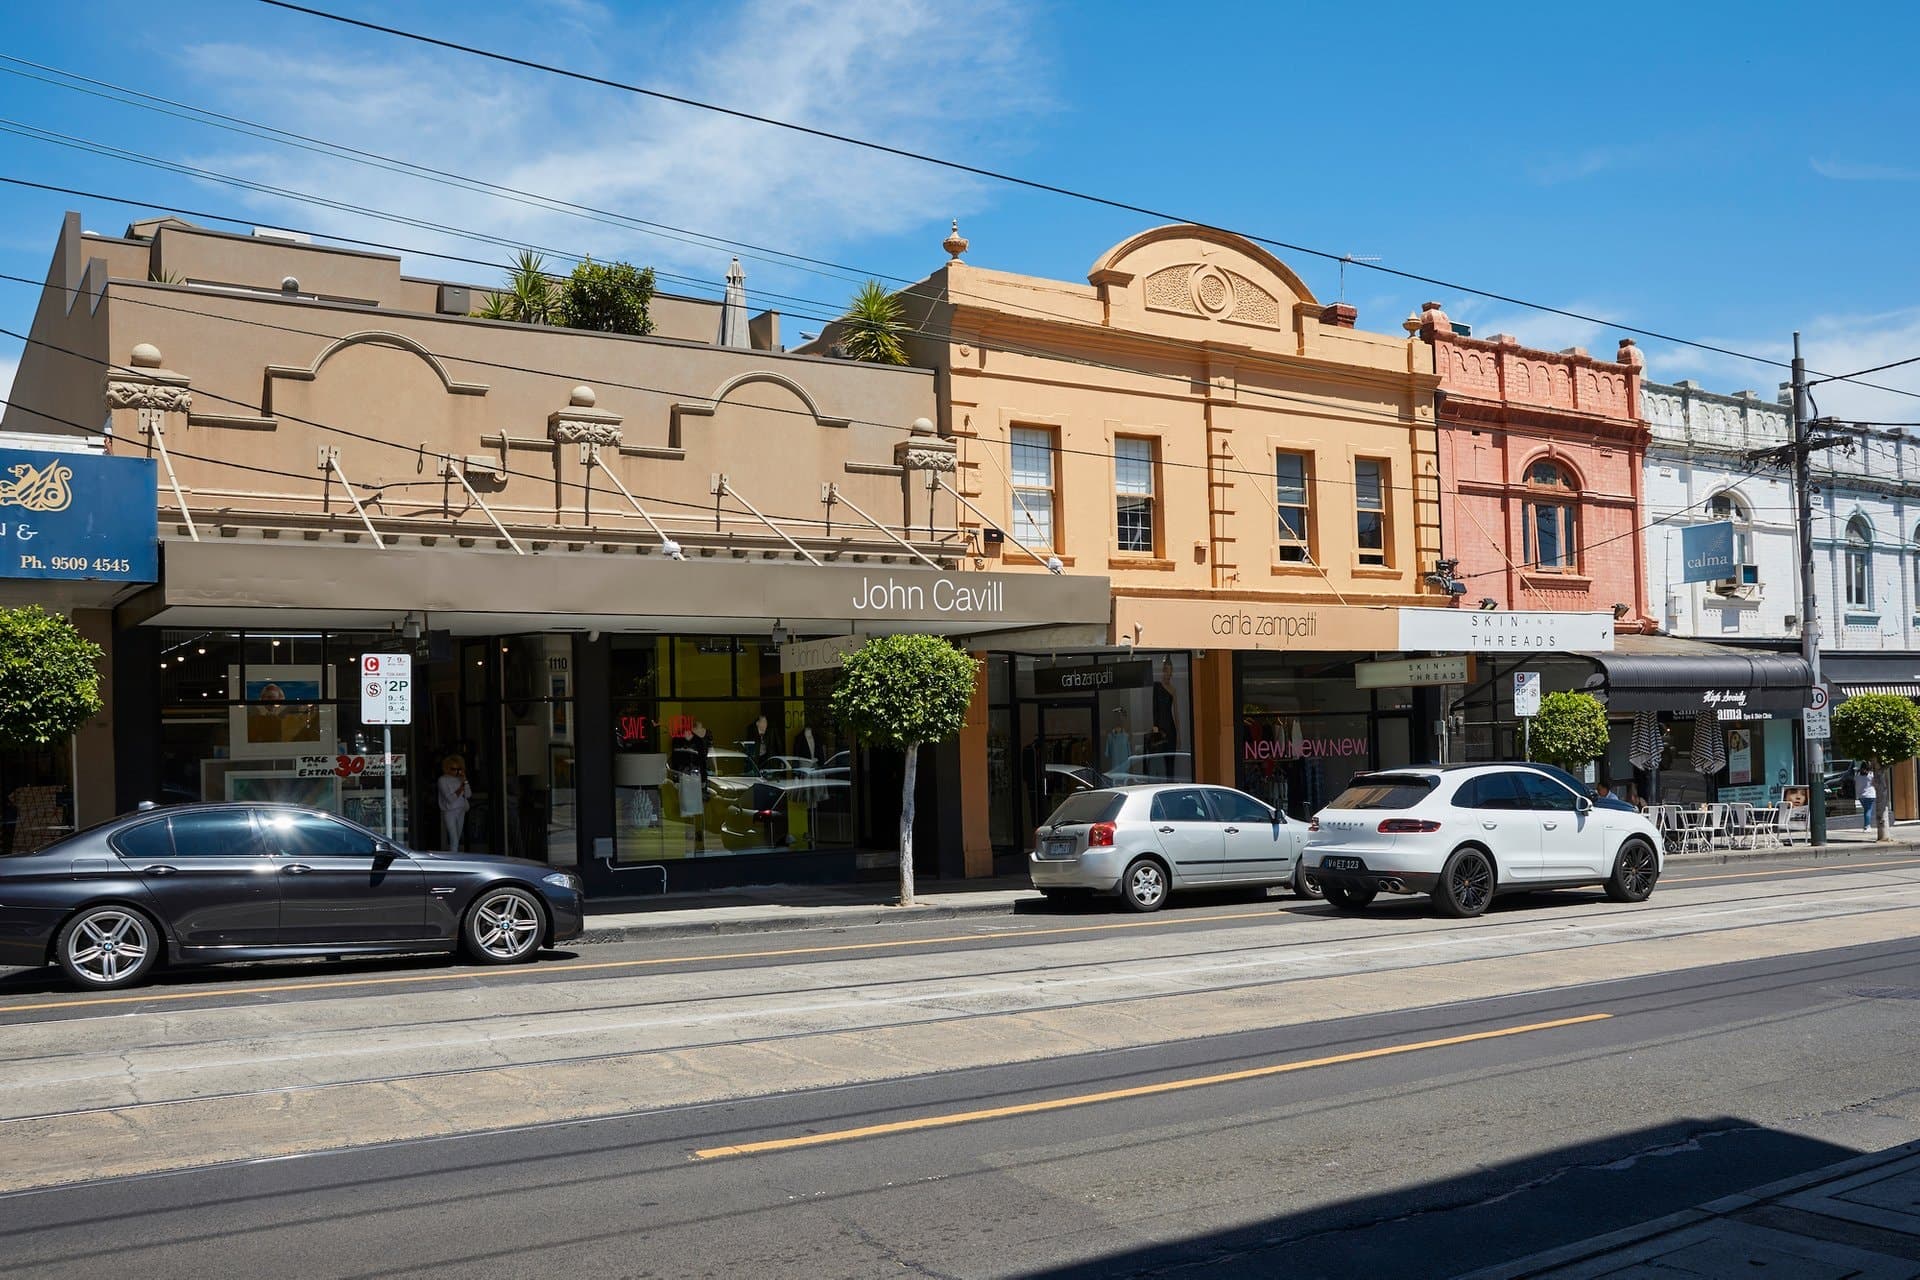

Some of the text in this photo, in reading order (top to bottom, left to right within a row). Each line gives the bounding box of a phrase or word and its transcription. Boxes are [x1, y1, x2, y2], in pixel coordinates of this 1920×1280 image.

[20, 555, 130, 573] Ph. 9509 4545
[1687, 551, 1729, 569] calma
[852, 577, 1003, 612] John Cavill
[1211, 609, 1317, 645] carla zampatti
[1471, 615, 1519, 627] SKIN
[1471, 635, 1556, 647] THREADS
[549, 657, 568, 670] 1110
[1408, 663, 1439, 671] SKIN
[1408, 672, 1465, 681] THREADS
[389, 680, 409, 692] 2P
[1703, 690, 1747, 707] High Society
[621, 717, 647, 739] SAVE
[298, 769, 335, 777] EXTRA
[335, 755, 365, 777] 30
